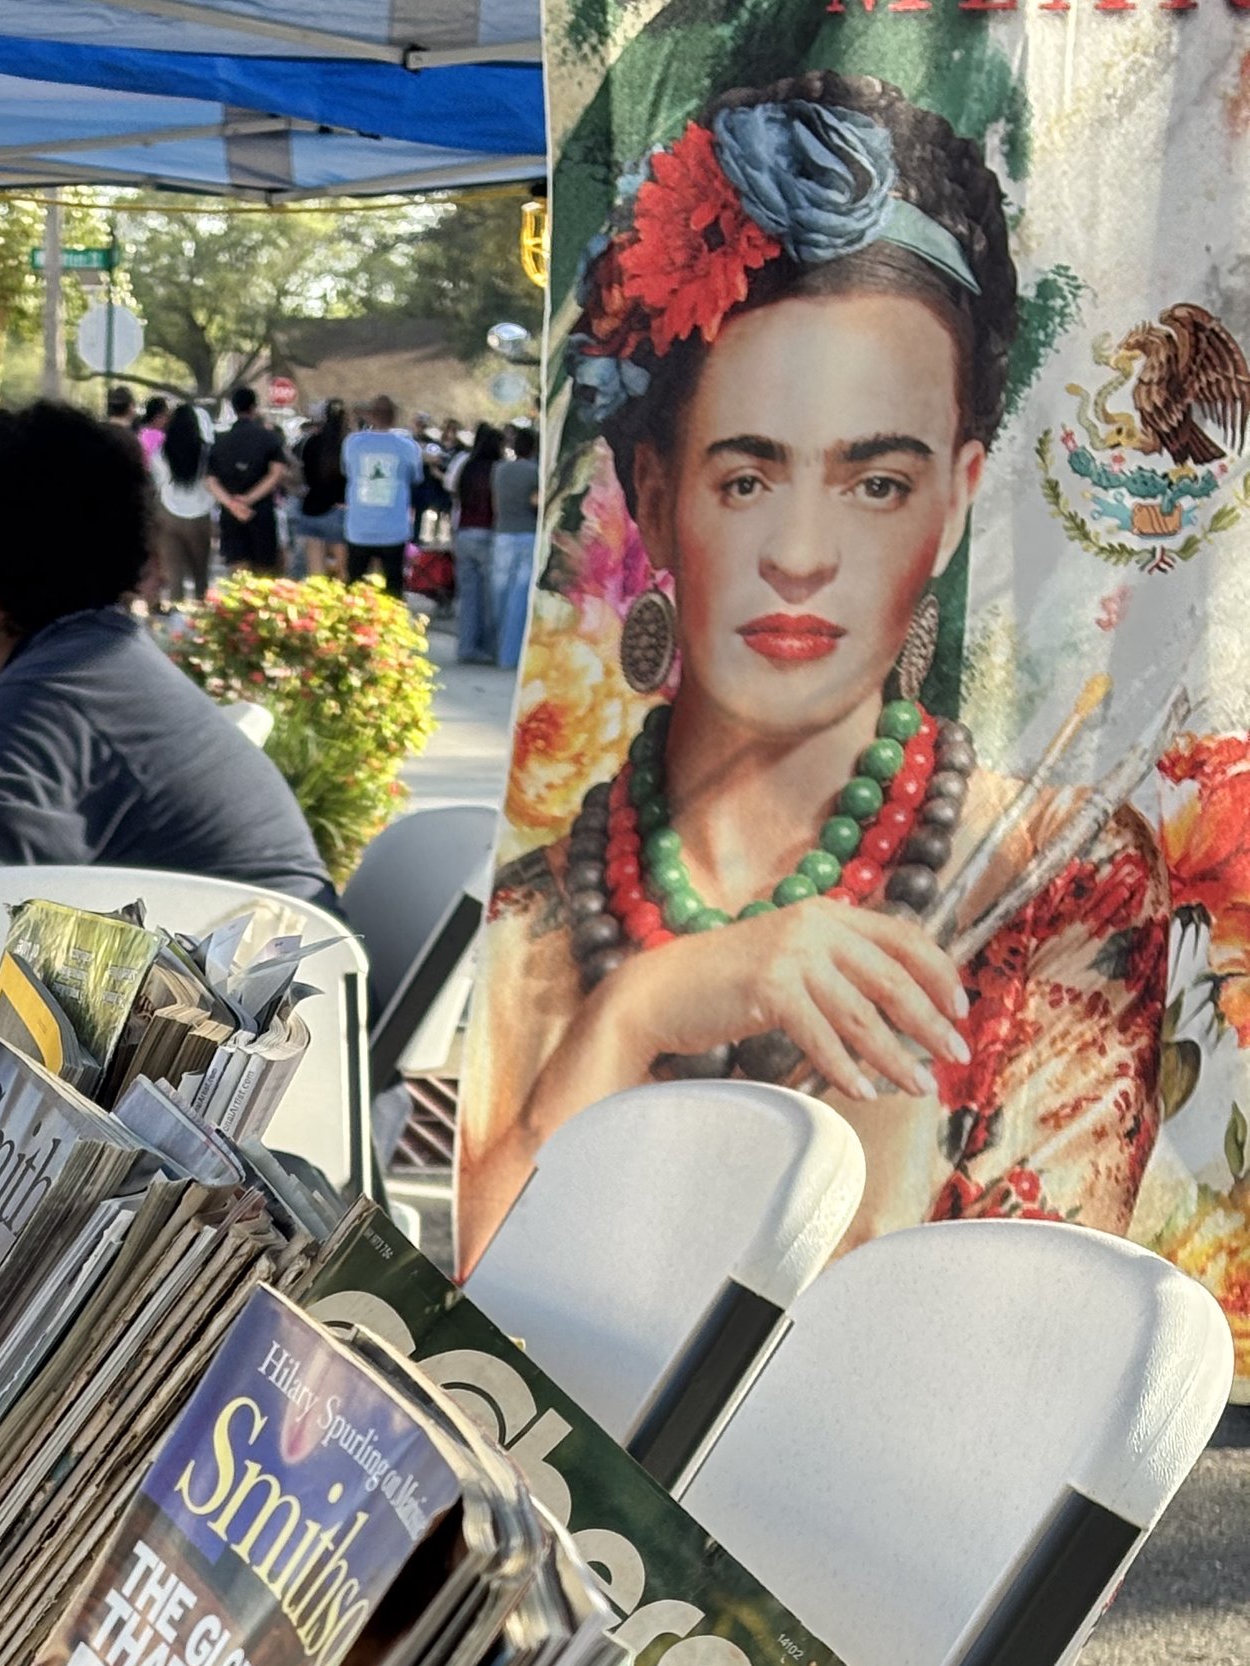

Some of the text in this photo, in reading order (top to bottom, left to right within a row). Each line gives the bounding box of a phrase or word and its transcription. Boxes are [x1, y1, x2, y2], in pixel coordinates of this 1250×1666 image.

[257, 1340, 319, 1423] Hilary
[316, 1394, 391, 1493] Spurling
[118, 1541, 196, 1628] THE
